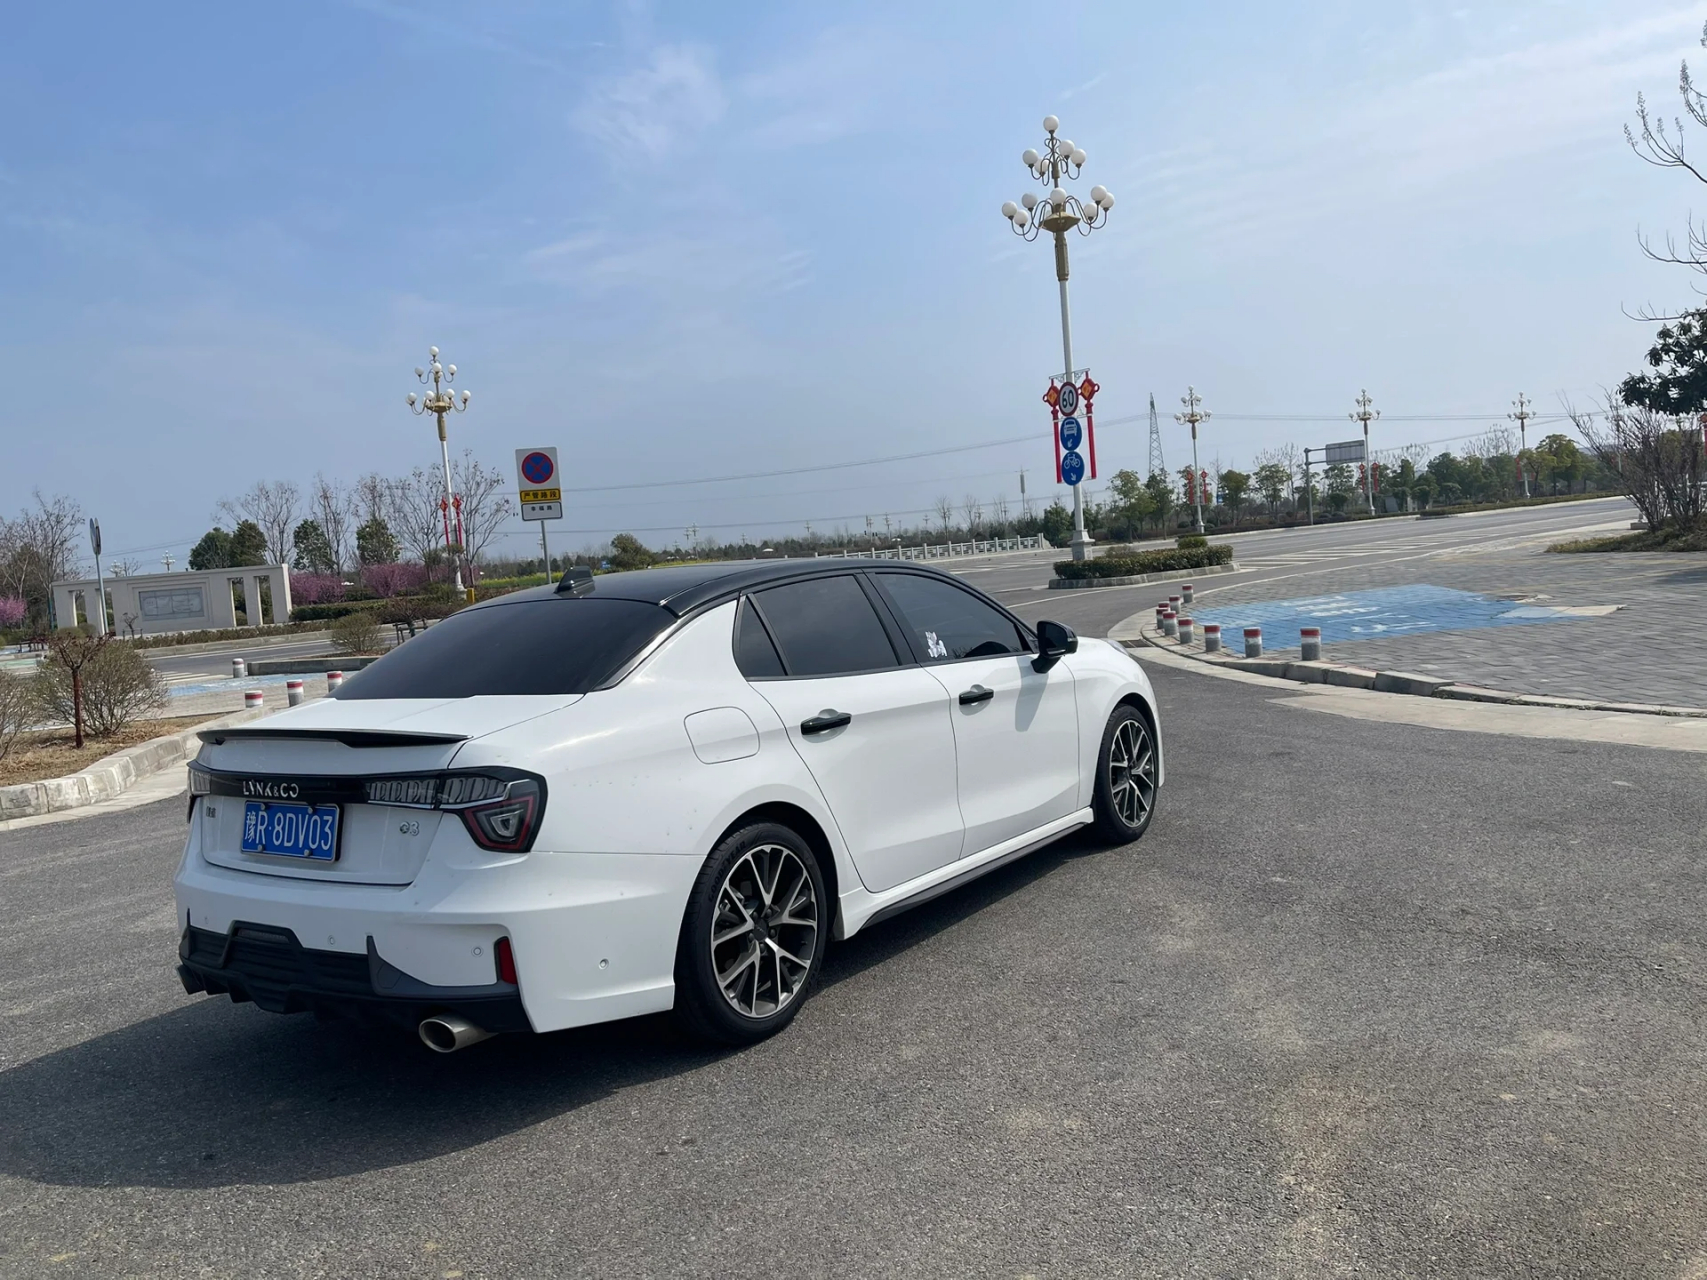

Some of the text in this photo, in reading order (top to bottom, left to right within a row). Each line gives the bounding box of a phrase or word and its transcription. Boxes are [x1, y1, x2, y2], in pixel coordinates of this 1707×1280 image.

[1061, 389, 1075, 408] 60
[523, 490, 557, 499] 严管路段
